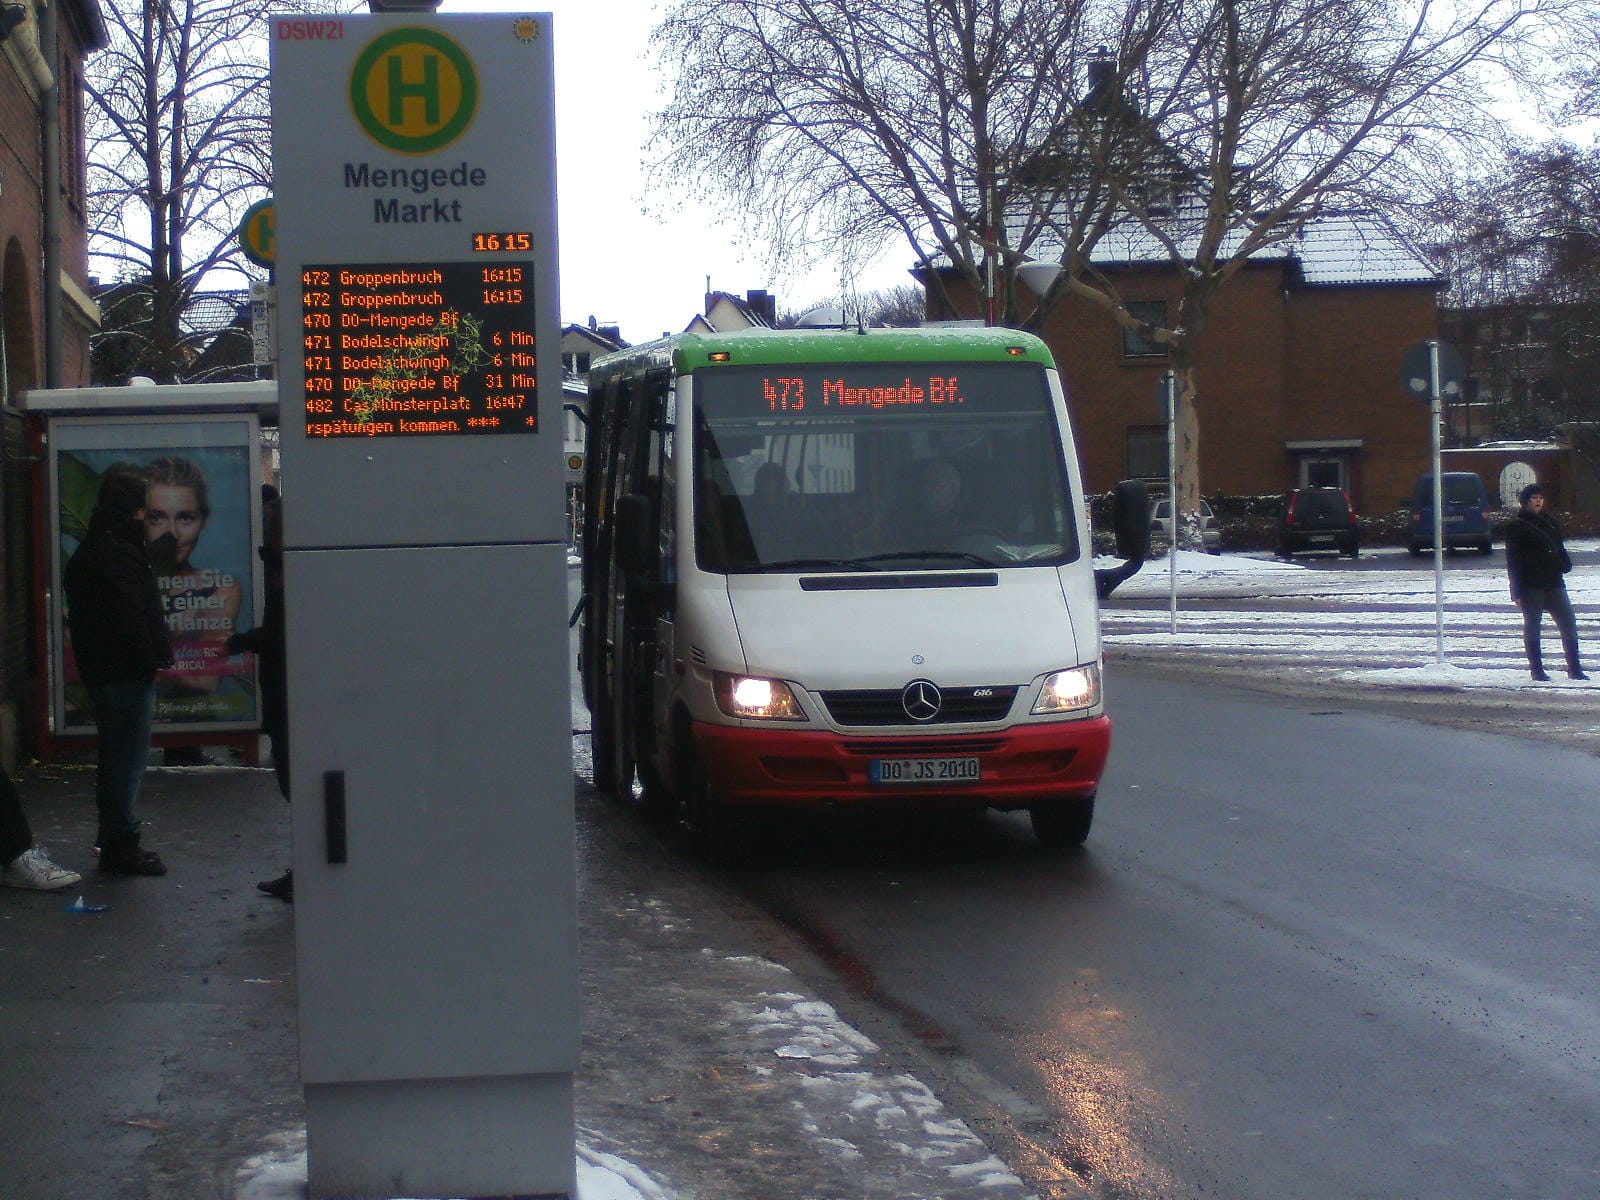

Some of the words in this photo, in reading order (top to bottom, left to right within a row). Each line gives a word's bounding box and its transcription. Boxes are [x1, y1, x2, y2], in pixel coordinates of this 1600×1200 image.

[387, 55, 441, 126] H
[344, 162, 487, 193] Mengede
[373, 198, 462, 223] Markt
[474, 234, 500, 251] 16
[505, 234, 531, 251] 15
[303, 271, 330, 286] 472
[340, 269, 443, 288] Groppenbruch
[482, 268, 523, 283] 16:15
[303, 292, 331, 307] 472
[341, 290, 444, 309] Groppenbruch
[483, 289, 523, 303] 16:15
[304, 313, 331, 328] 470
[341, 312, 435, 330] DO-Mengede
[441, 311, 460, 329] Bf
[304, 334, 332, 349] 471
[342, 333, 450, 350] Bodelschwingh
[492, 332, 503, 346] 6
[511, 331, 535, 346] Min
[305, 355, 332, 371] 471
[493, 353, 503, 368] 6
[512, 352, 536, 367] Min
[306, 377, 333, 392] 470
[442, 375, 461, 392] Bf
[486, 374, 504, 389] 31
[512, 373, 536, 388] Min
[763, 377, 804, 410] 473
[823, 377, 924, 408] Mengede
[929, 376, 965, 403] Bf.
[306, 398, 333, 413] 482
[485, 395, 525, 410] 16:47
[200, 569, 233, 588] Sie
[174, 590, 226, 610] einer
[164, 613, 233, 632] flanze
[973, 688, 993, 697] 616
[881, 762, 902, 779] DO
[914, 761, 935, 779] JS
[938, 760, 978, 779] 2010
